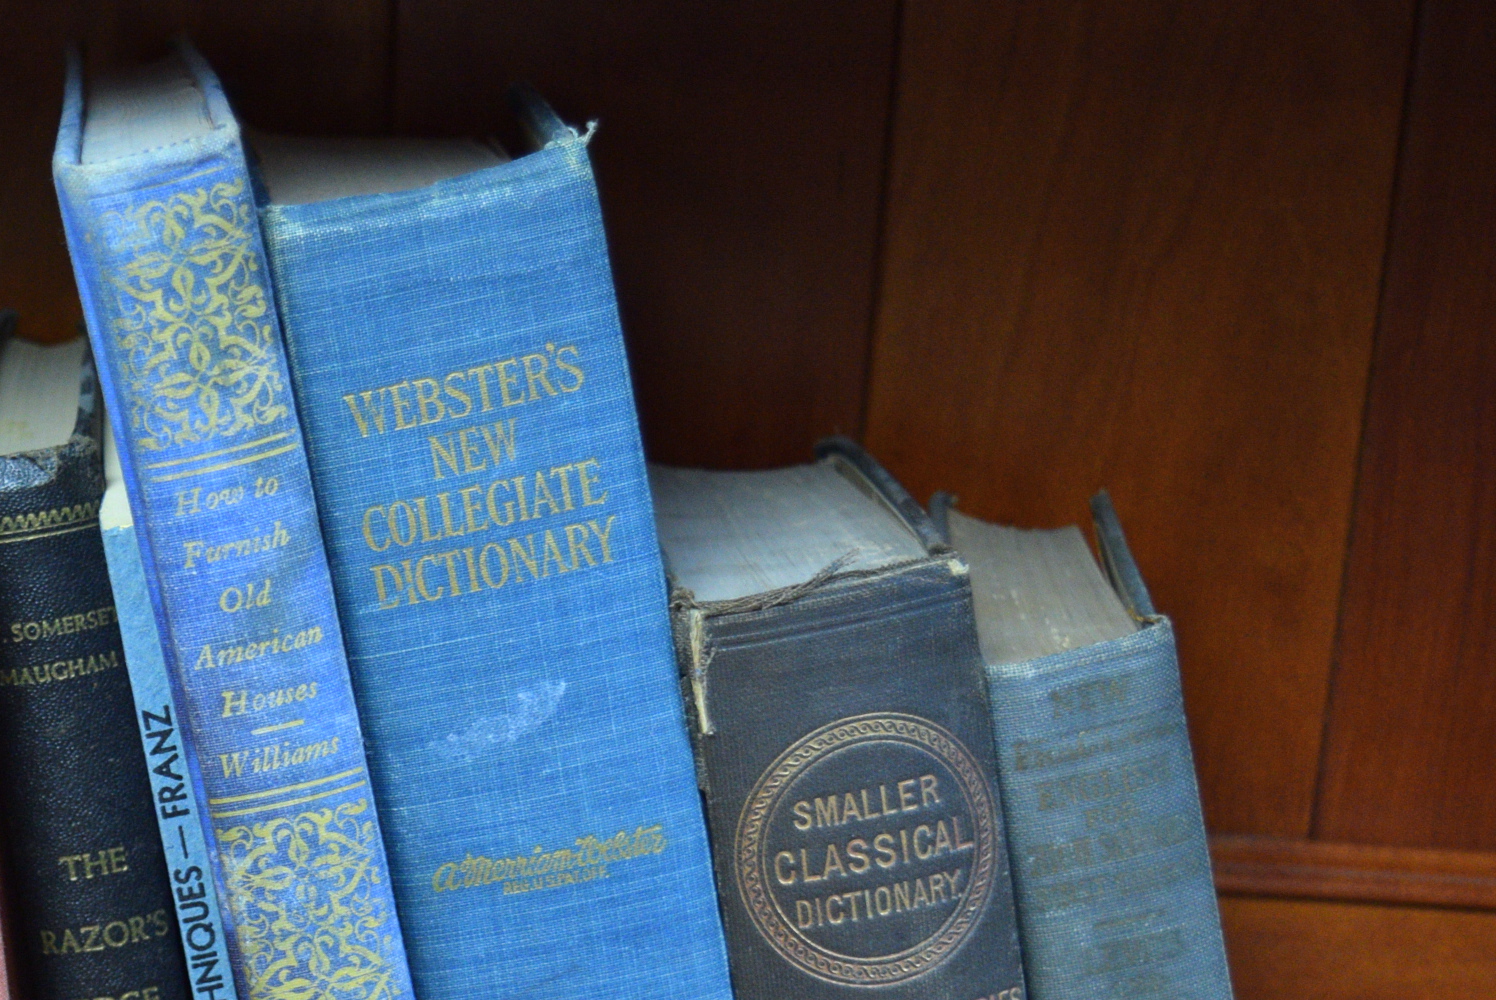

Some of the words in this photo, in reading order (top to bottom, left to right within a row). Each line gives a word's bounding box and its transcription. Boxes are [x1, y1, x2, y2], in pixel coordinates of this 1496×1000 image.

[342, 341, 586, 438] WEBSTER'S
[426, 418, 518, 480] NEW
[175, 484, 246, 516] How
[254, 477, 279, 497] to
[362, 457, 609, 553] COLLEGIATE
[183, 521, 292, 569] Furnish
[370, 515, 617, 611] DICTIONARY
[219, 579, 273, 614] Old
[11, 606, 118, 643] SOMERSET
[194, 625, 325, 670] American
[220, 681, 319, 718] Houses
[141, 704, 186, 820] FRANZ
[218, 736, 341, 779] Williams
[793, 774, 941, 832] SMALLER
[58, 846, 129, 882] THE
[774, 817, 974, 886] CLASSICAL
[41, 909, 169, 955] RAZOR'S
